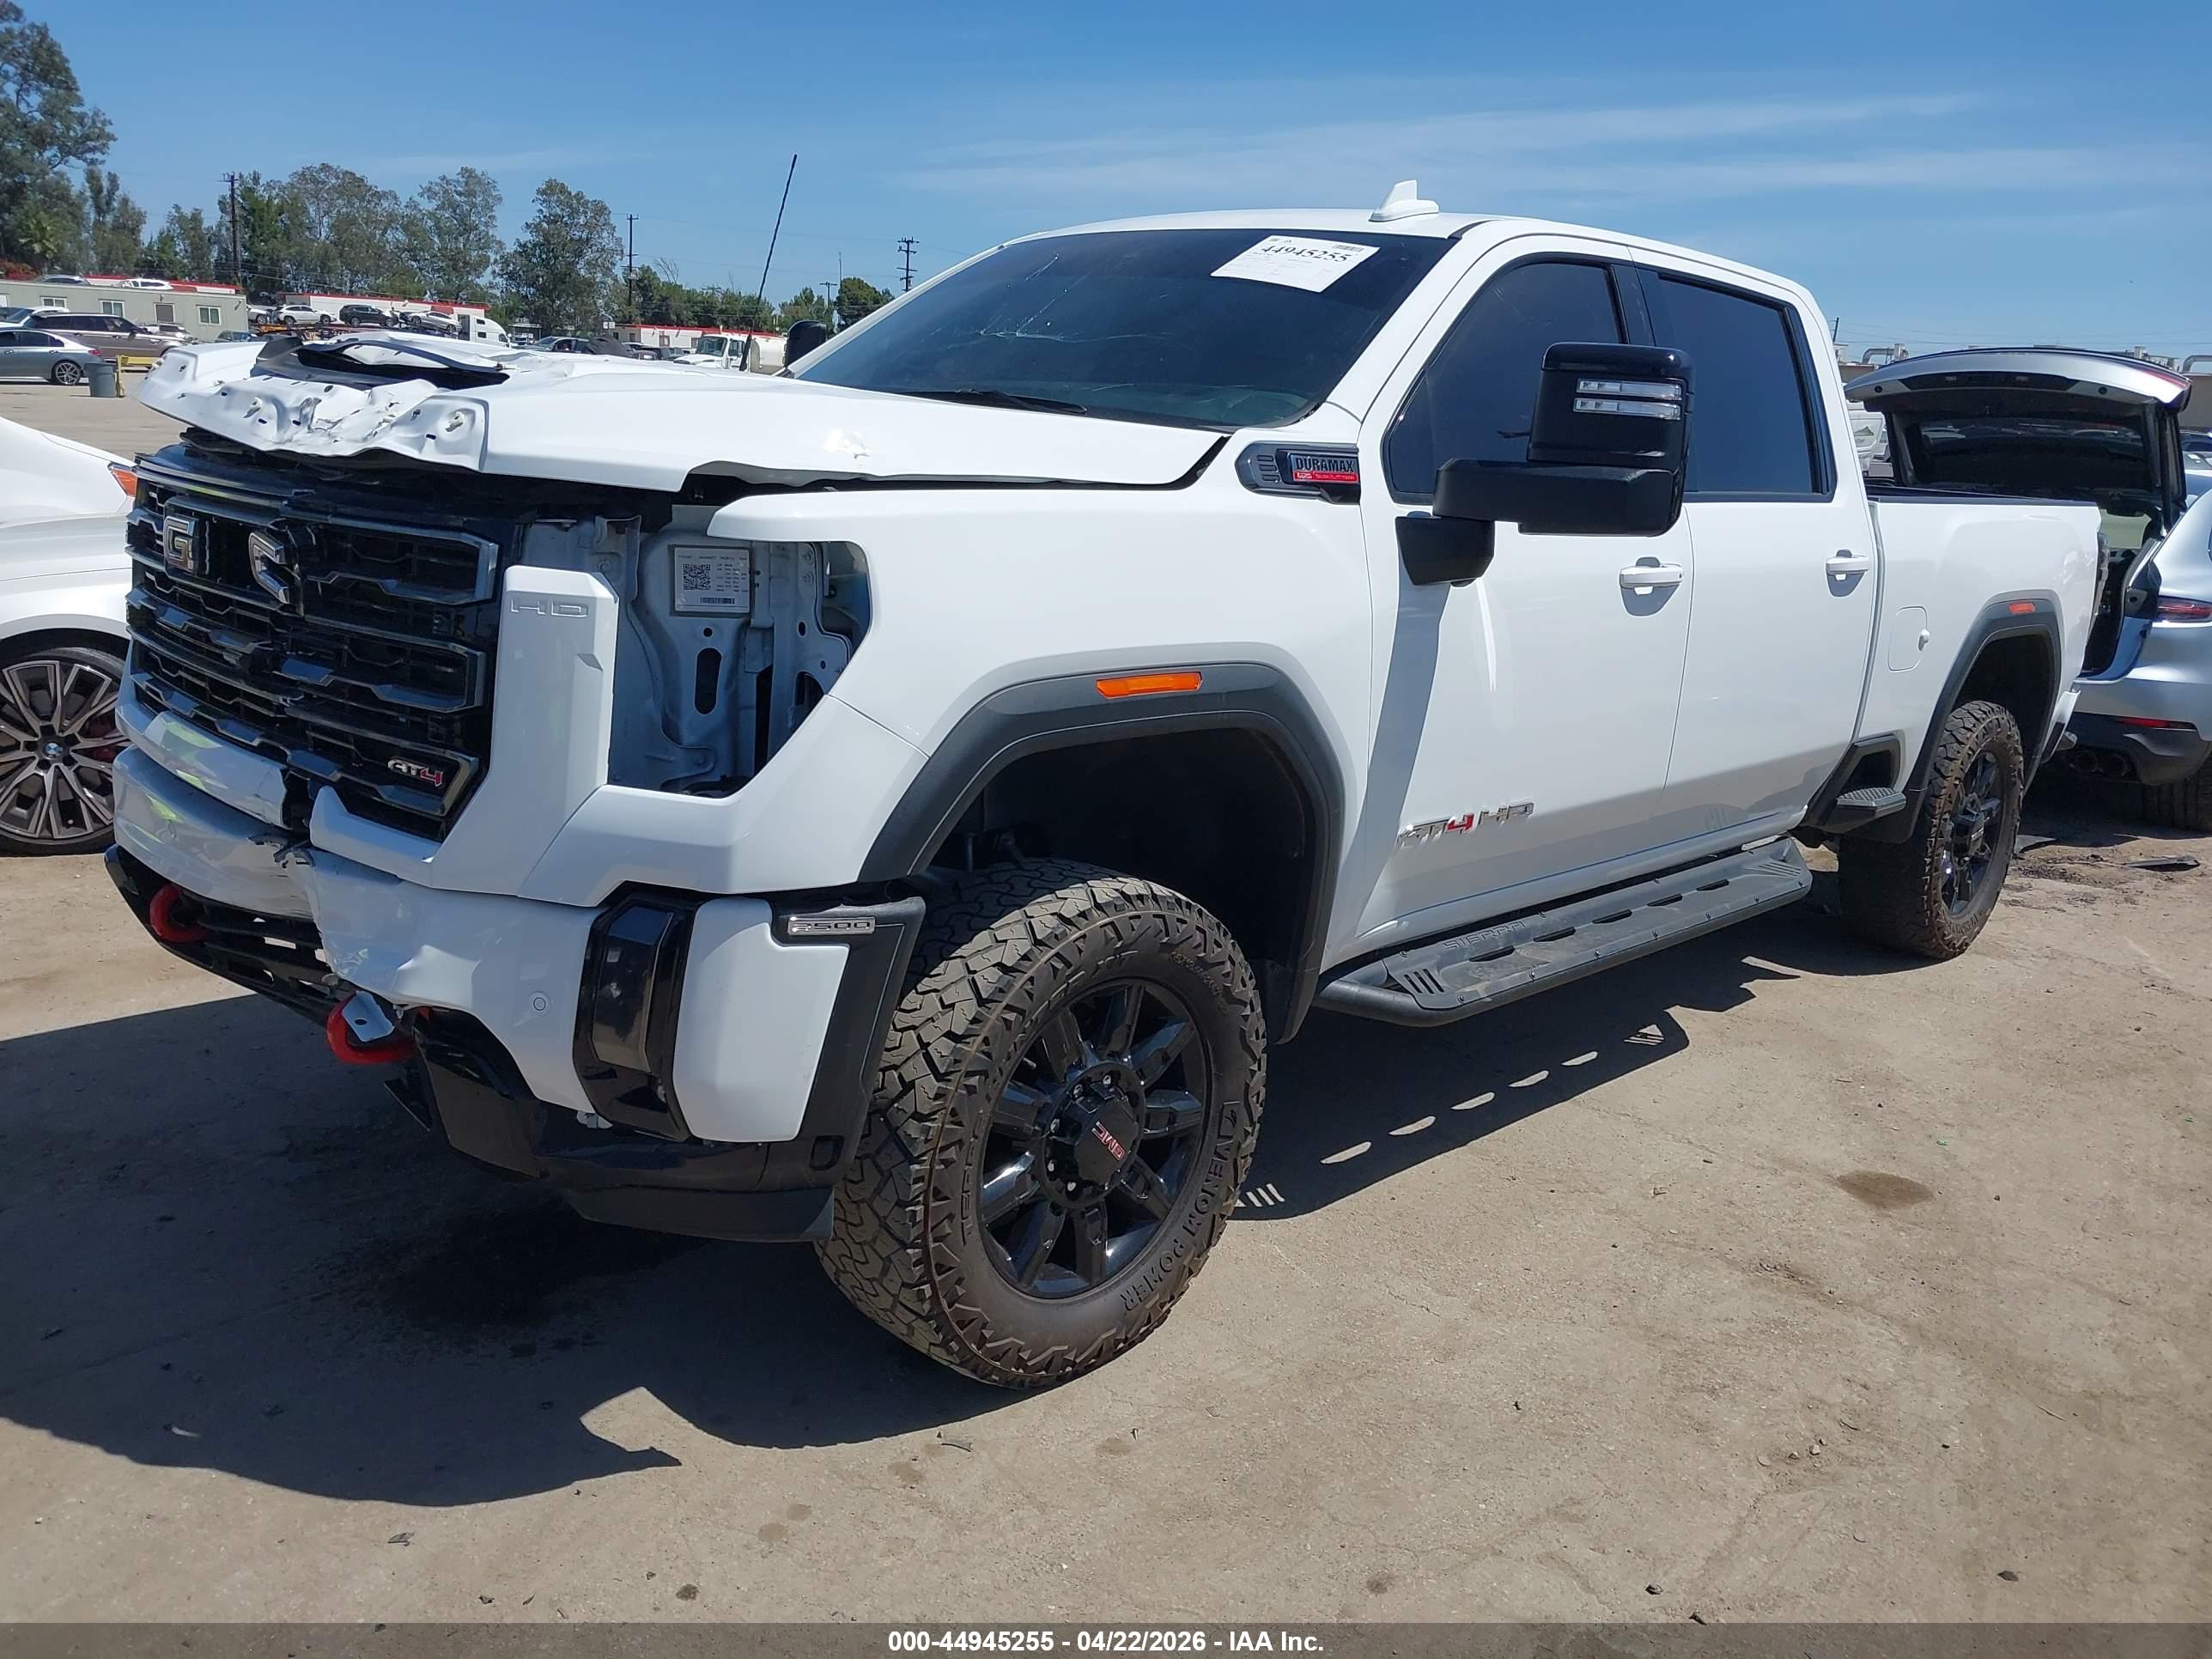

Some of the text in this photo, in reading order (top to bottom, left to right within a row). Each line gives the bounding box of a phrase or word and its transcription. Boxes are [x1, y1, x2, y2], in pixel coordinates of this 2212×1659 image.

[1261, 246, 1352, 262] 44945255
[1296, 458, 1354, 472] DURAMAX
[510, 598, 588, 617] HD
[387, 757, 443, 787] AT4
[1479, 803, 1534, 824] HD
[1443, 921, 1525, 951] SIERRA
[1091, 1121, 1125, 1160] GMC
[1120, 1144, 1233, 1311] VENOM POWER
